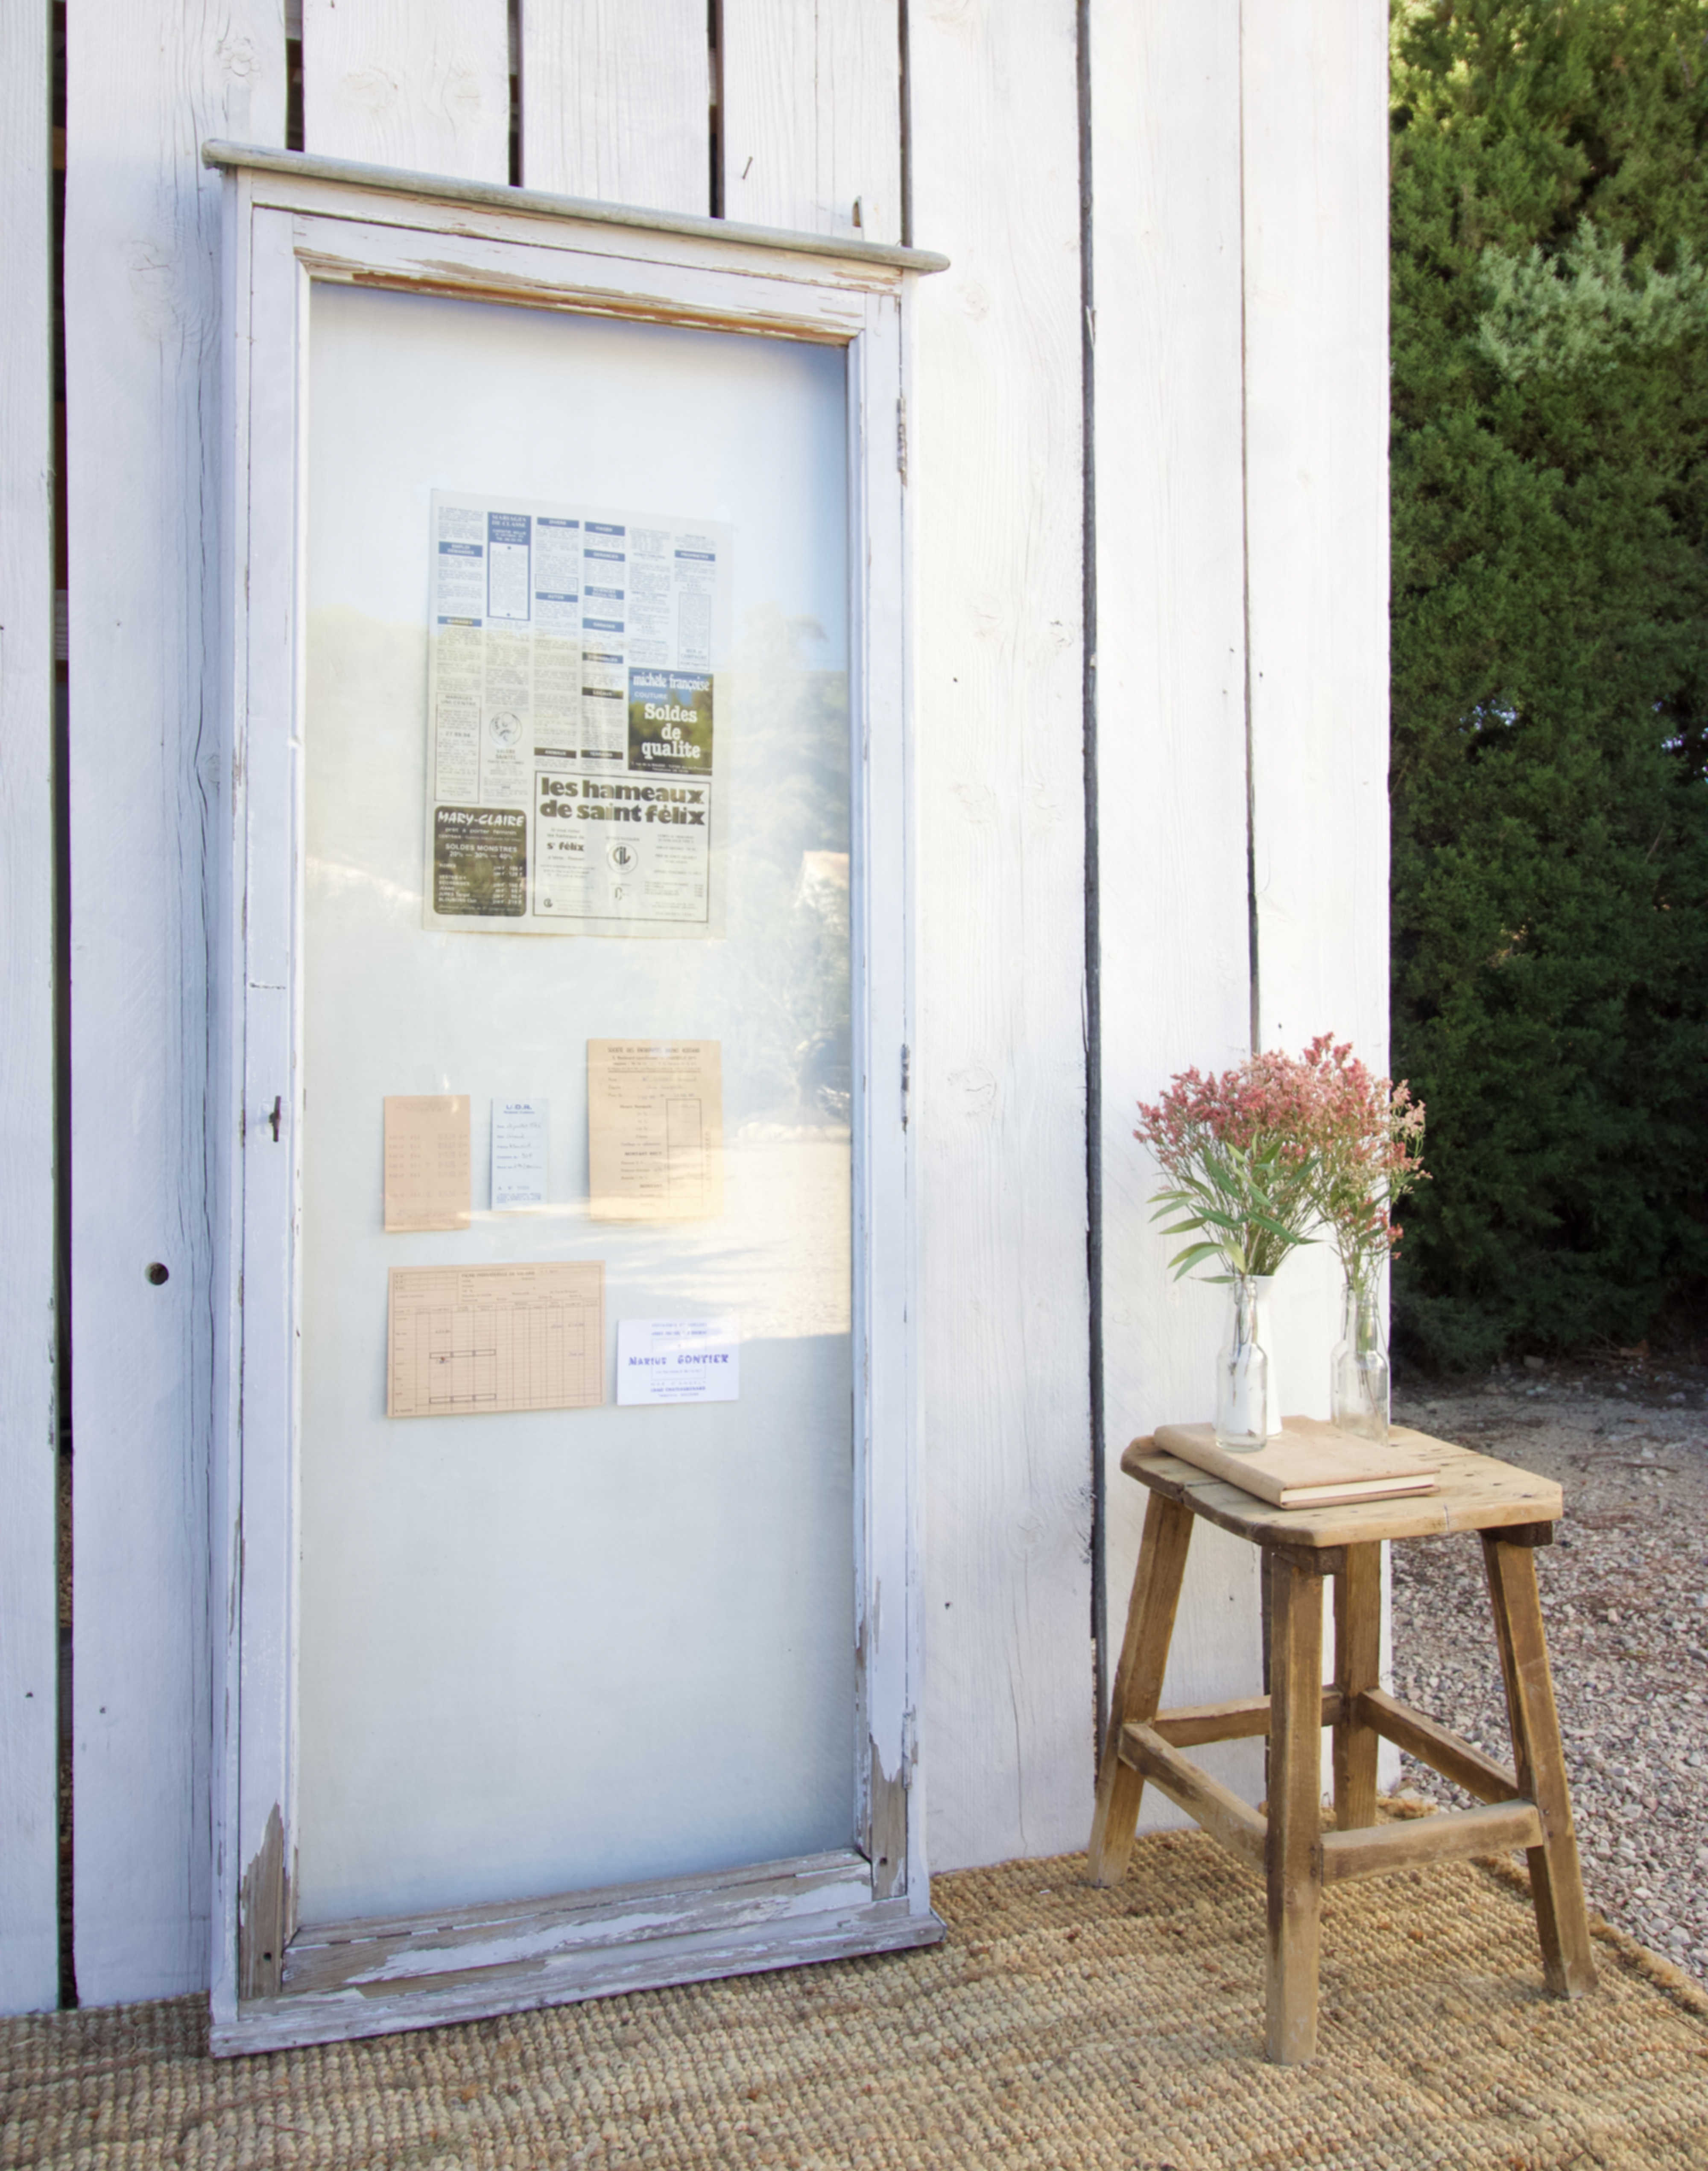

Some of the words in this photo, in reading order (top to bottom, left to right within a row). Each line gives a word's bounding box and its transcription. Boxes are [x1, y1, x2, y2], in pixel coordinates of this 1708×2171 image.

[669, 673, 710, 692] françoise
[634, 691, 668, 700] COUTURE
[644, 702, 698, 723] Soldes
[661, 723, 681, 741] de
[541, 777, 578, 797] les
[582, 779, 705, 805] hameaux
[437, 810, 524, 827] MARY-CLAIRE
[539, 799, 573, 819] de
[576, 802, 642, 822] saint
[644, 804, 705, 826] félix
[445, 843, 474, 851] SOLDES
[477, 845, 518, 853] MONSTRES
